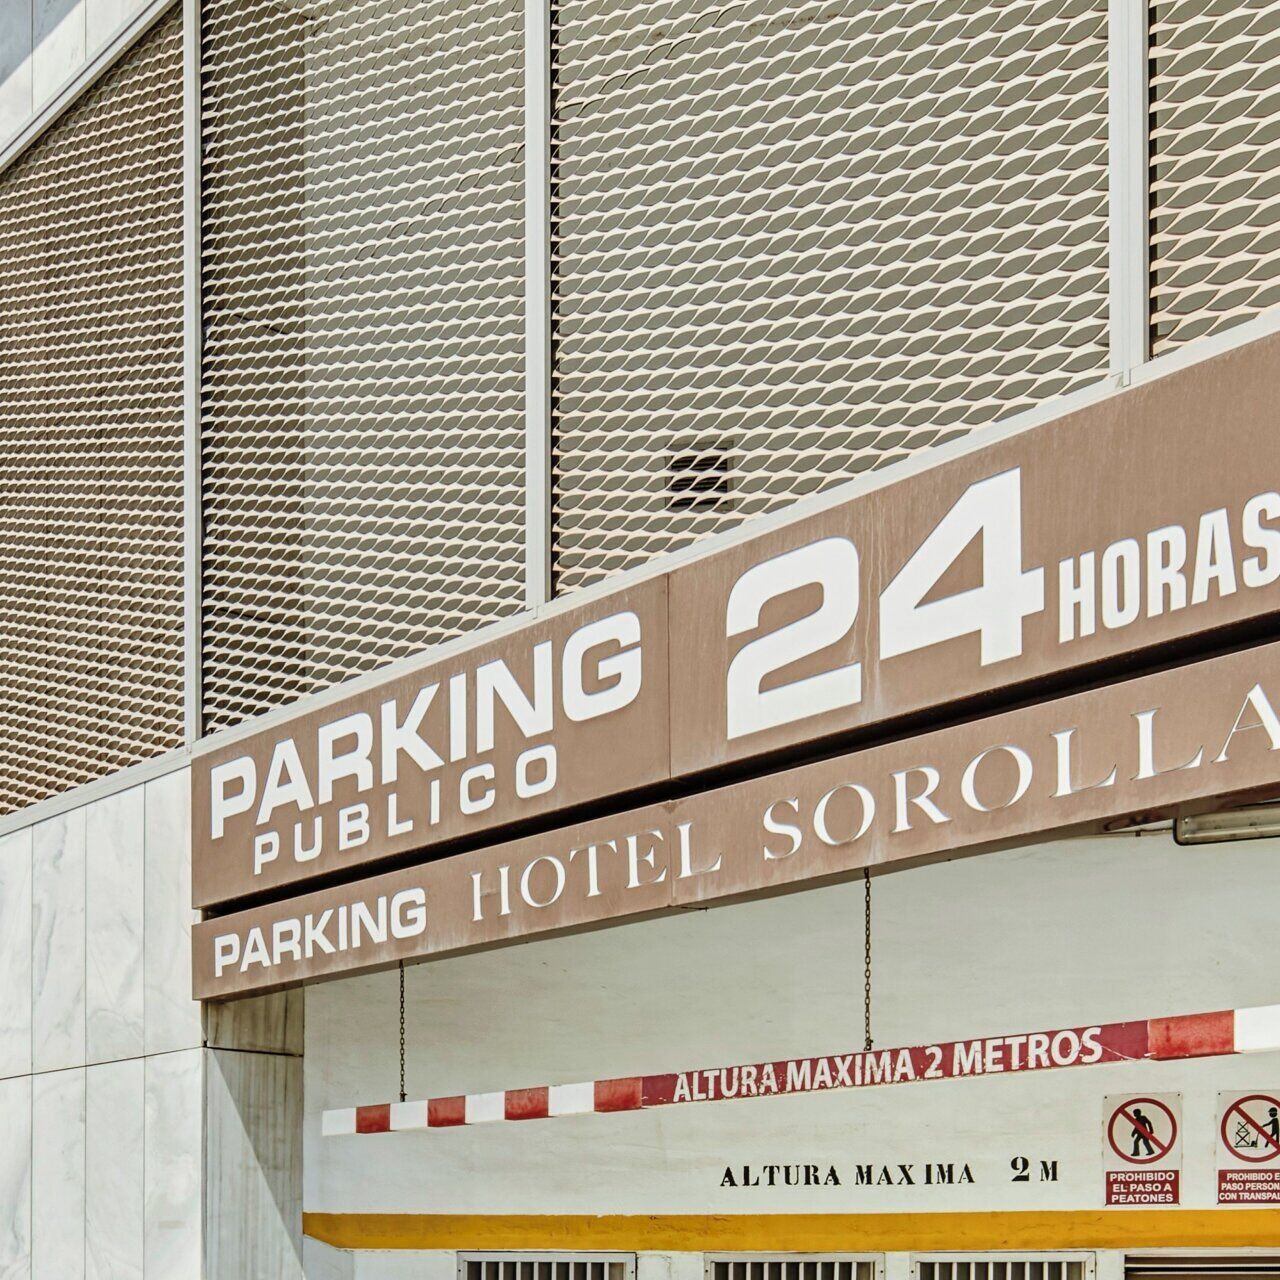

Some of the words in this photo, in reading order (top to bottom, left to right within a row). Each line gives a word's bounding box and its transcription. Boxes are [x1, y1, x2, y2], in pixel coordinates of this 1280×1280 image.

[726, 467, 1045, 740] 24
[210, 611, 642, 839] PARKING
[253, 744, 557, 875] PUBLICO
[214, 887, 427, 978] PARKING
[472, 822, 722, 922] HOTEL
[673, 1066, 778, 1103] ALTURA
[785, 1047, 915, 1093] MAXIMA
[924, 1045, 944, 1079] 2
[952, 1026, 1103, 1077] METROS
[720, 1164, 842, 1187] ALTURA
[854, 1162, 976, 1186] MAXIMA
[1109, 1171, 1175, 1182] PROHIBIDO
[1226, 1172, 1273, 1181] PROHIBIDO
[1112, 1183, 1128, 1193] EL
[1130, 1183, 1160, 1192] PASO
[1163, 1182, 1172, 1192] A
[1221, 1182, 1244, 1191] PASO
[1111, 1193, 1174, 1203] PEATONES
[1219, 1192, 1238, 1201] CON
